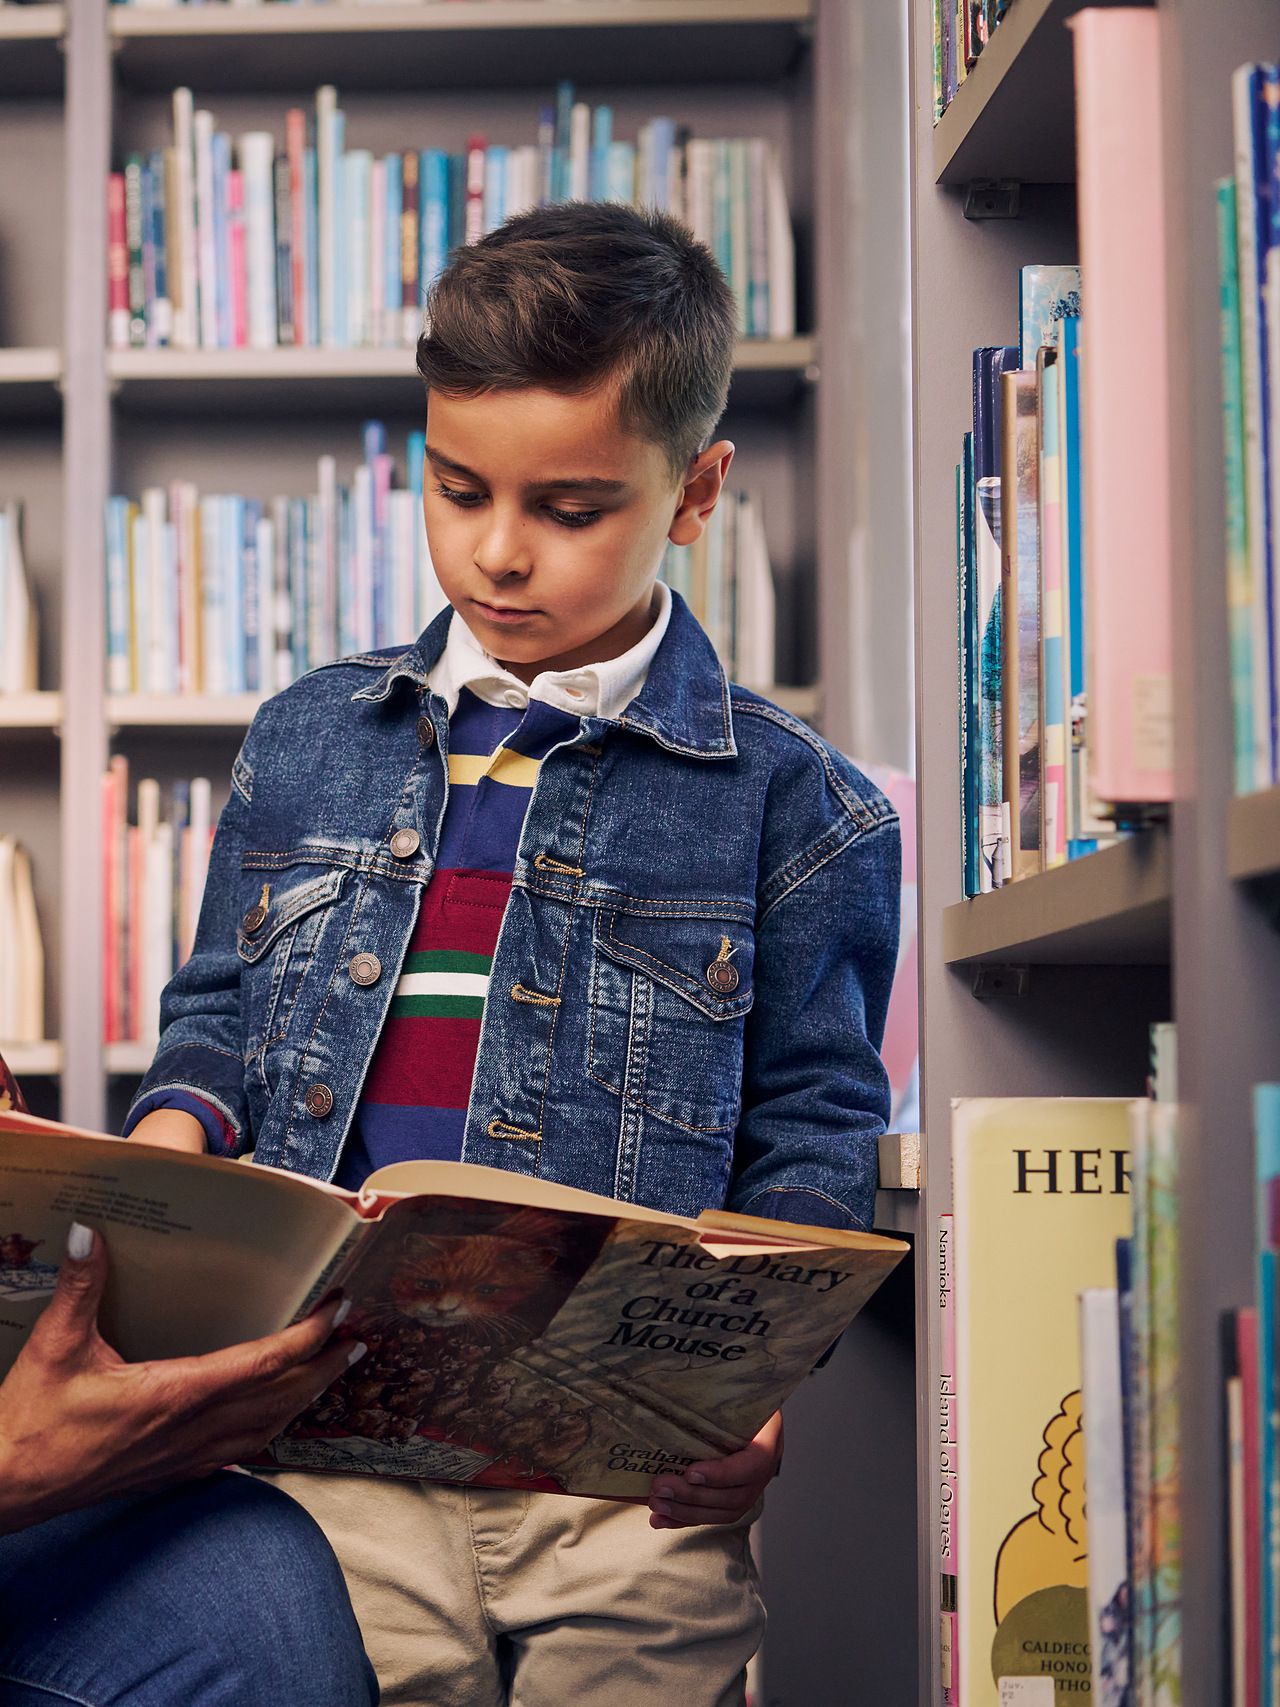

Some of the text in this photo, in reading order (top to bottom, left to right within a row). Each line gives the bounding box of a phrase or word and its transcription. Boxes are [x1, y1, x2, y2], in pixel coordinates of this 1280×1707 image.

[638, 1240, 855, 1293] The Diary
[939, 1230, 951, 1308] Namioka
[686, 1278, 758, 1306] of a
[621, 1295, 770, 1337] Church
[603, 1321, 747, 1361] Mouse
[940, 1374, 957, 1558] Island of Ogres
[1040, 1660, 1093, 1674] HONO
[1054, 1677, 1092, 1693] THO
